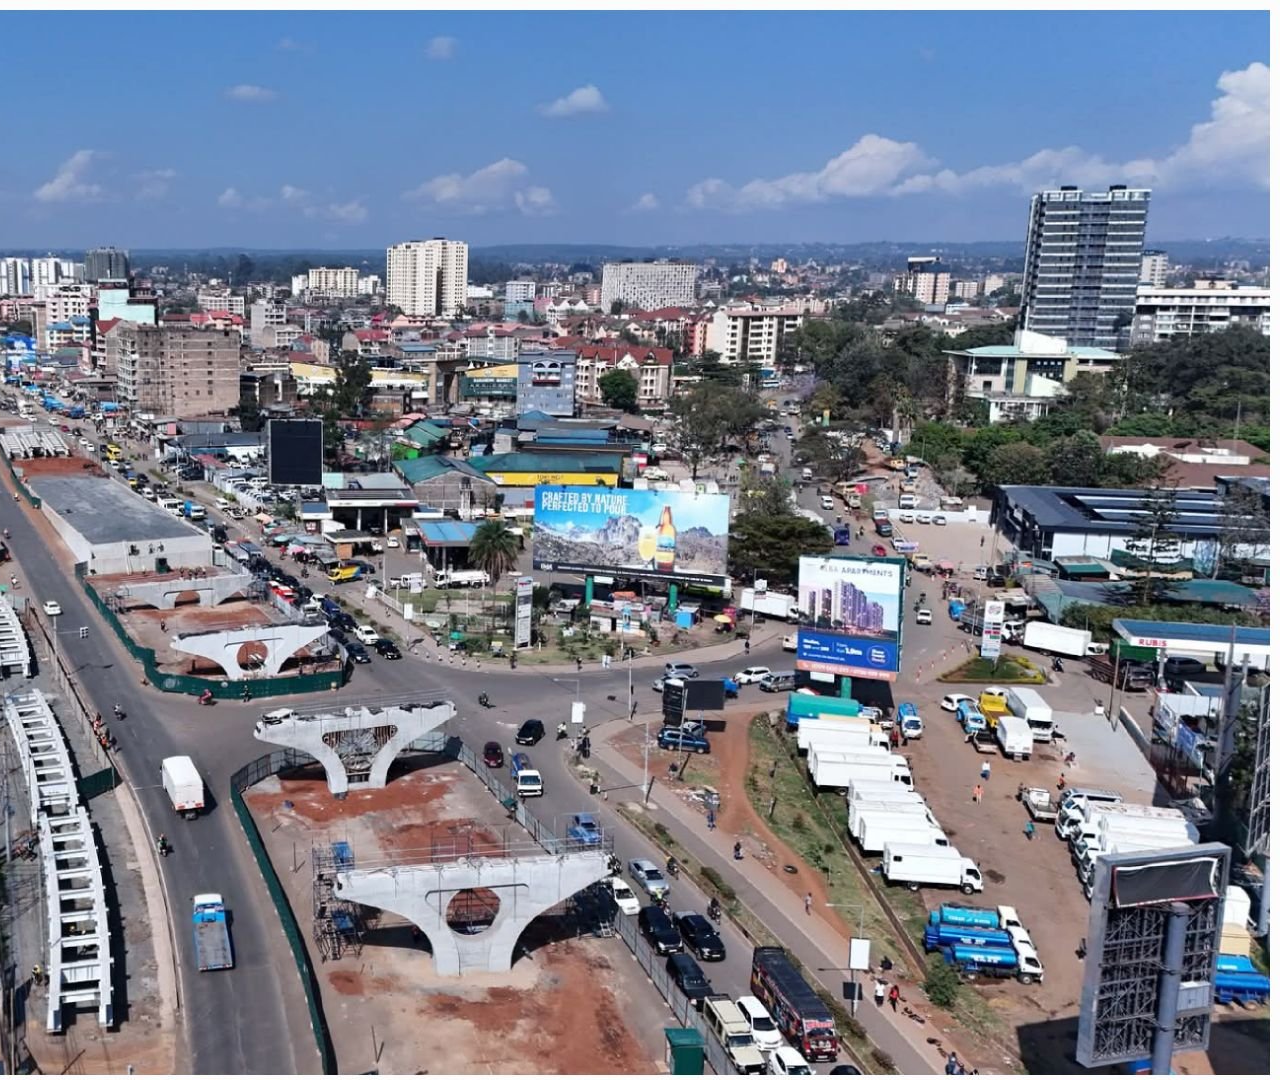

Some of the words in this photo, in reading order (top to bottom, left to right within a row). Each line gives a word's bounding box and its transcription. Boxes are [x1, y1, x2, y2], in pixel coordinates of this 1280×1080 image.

[541, 491, 580, 502] CRAFTED
[582, 493, 593, 502] BY
[595, 494, 627, 504] NATURE
[541, 502, 588, 513] PERFECTED
[590, 503, 602, 513] TO
